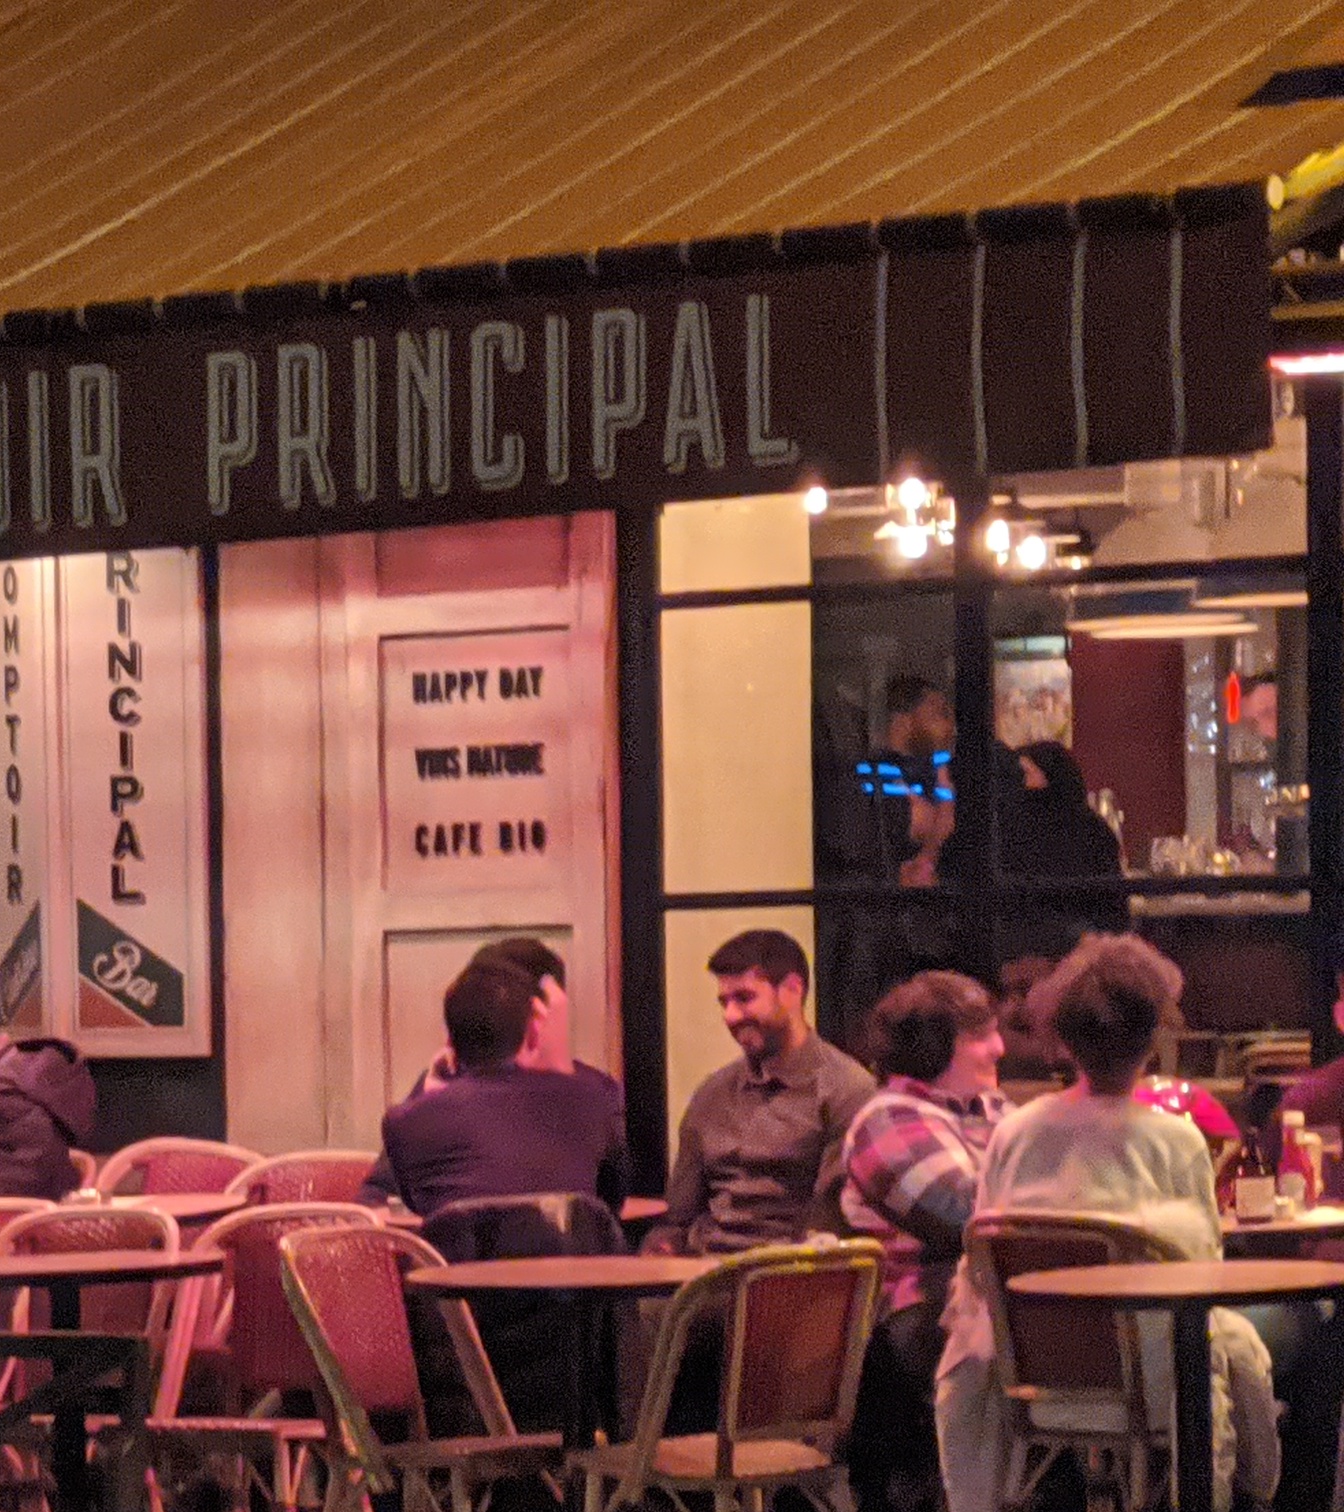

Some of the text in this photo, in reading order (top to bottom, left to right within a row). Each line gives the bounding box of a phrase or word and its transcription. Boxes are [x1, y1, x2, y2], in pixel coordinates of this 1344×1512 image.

[207, 294, 800, 516] PRINCIPAL
[3, 566, 23, 905] OMPTOIR
[106, 551, 146, 905] RINCIPAL
[412, 665, 544, 704] HAPPY DAY
[499, 819, 547, 855] BIO
